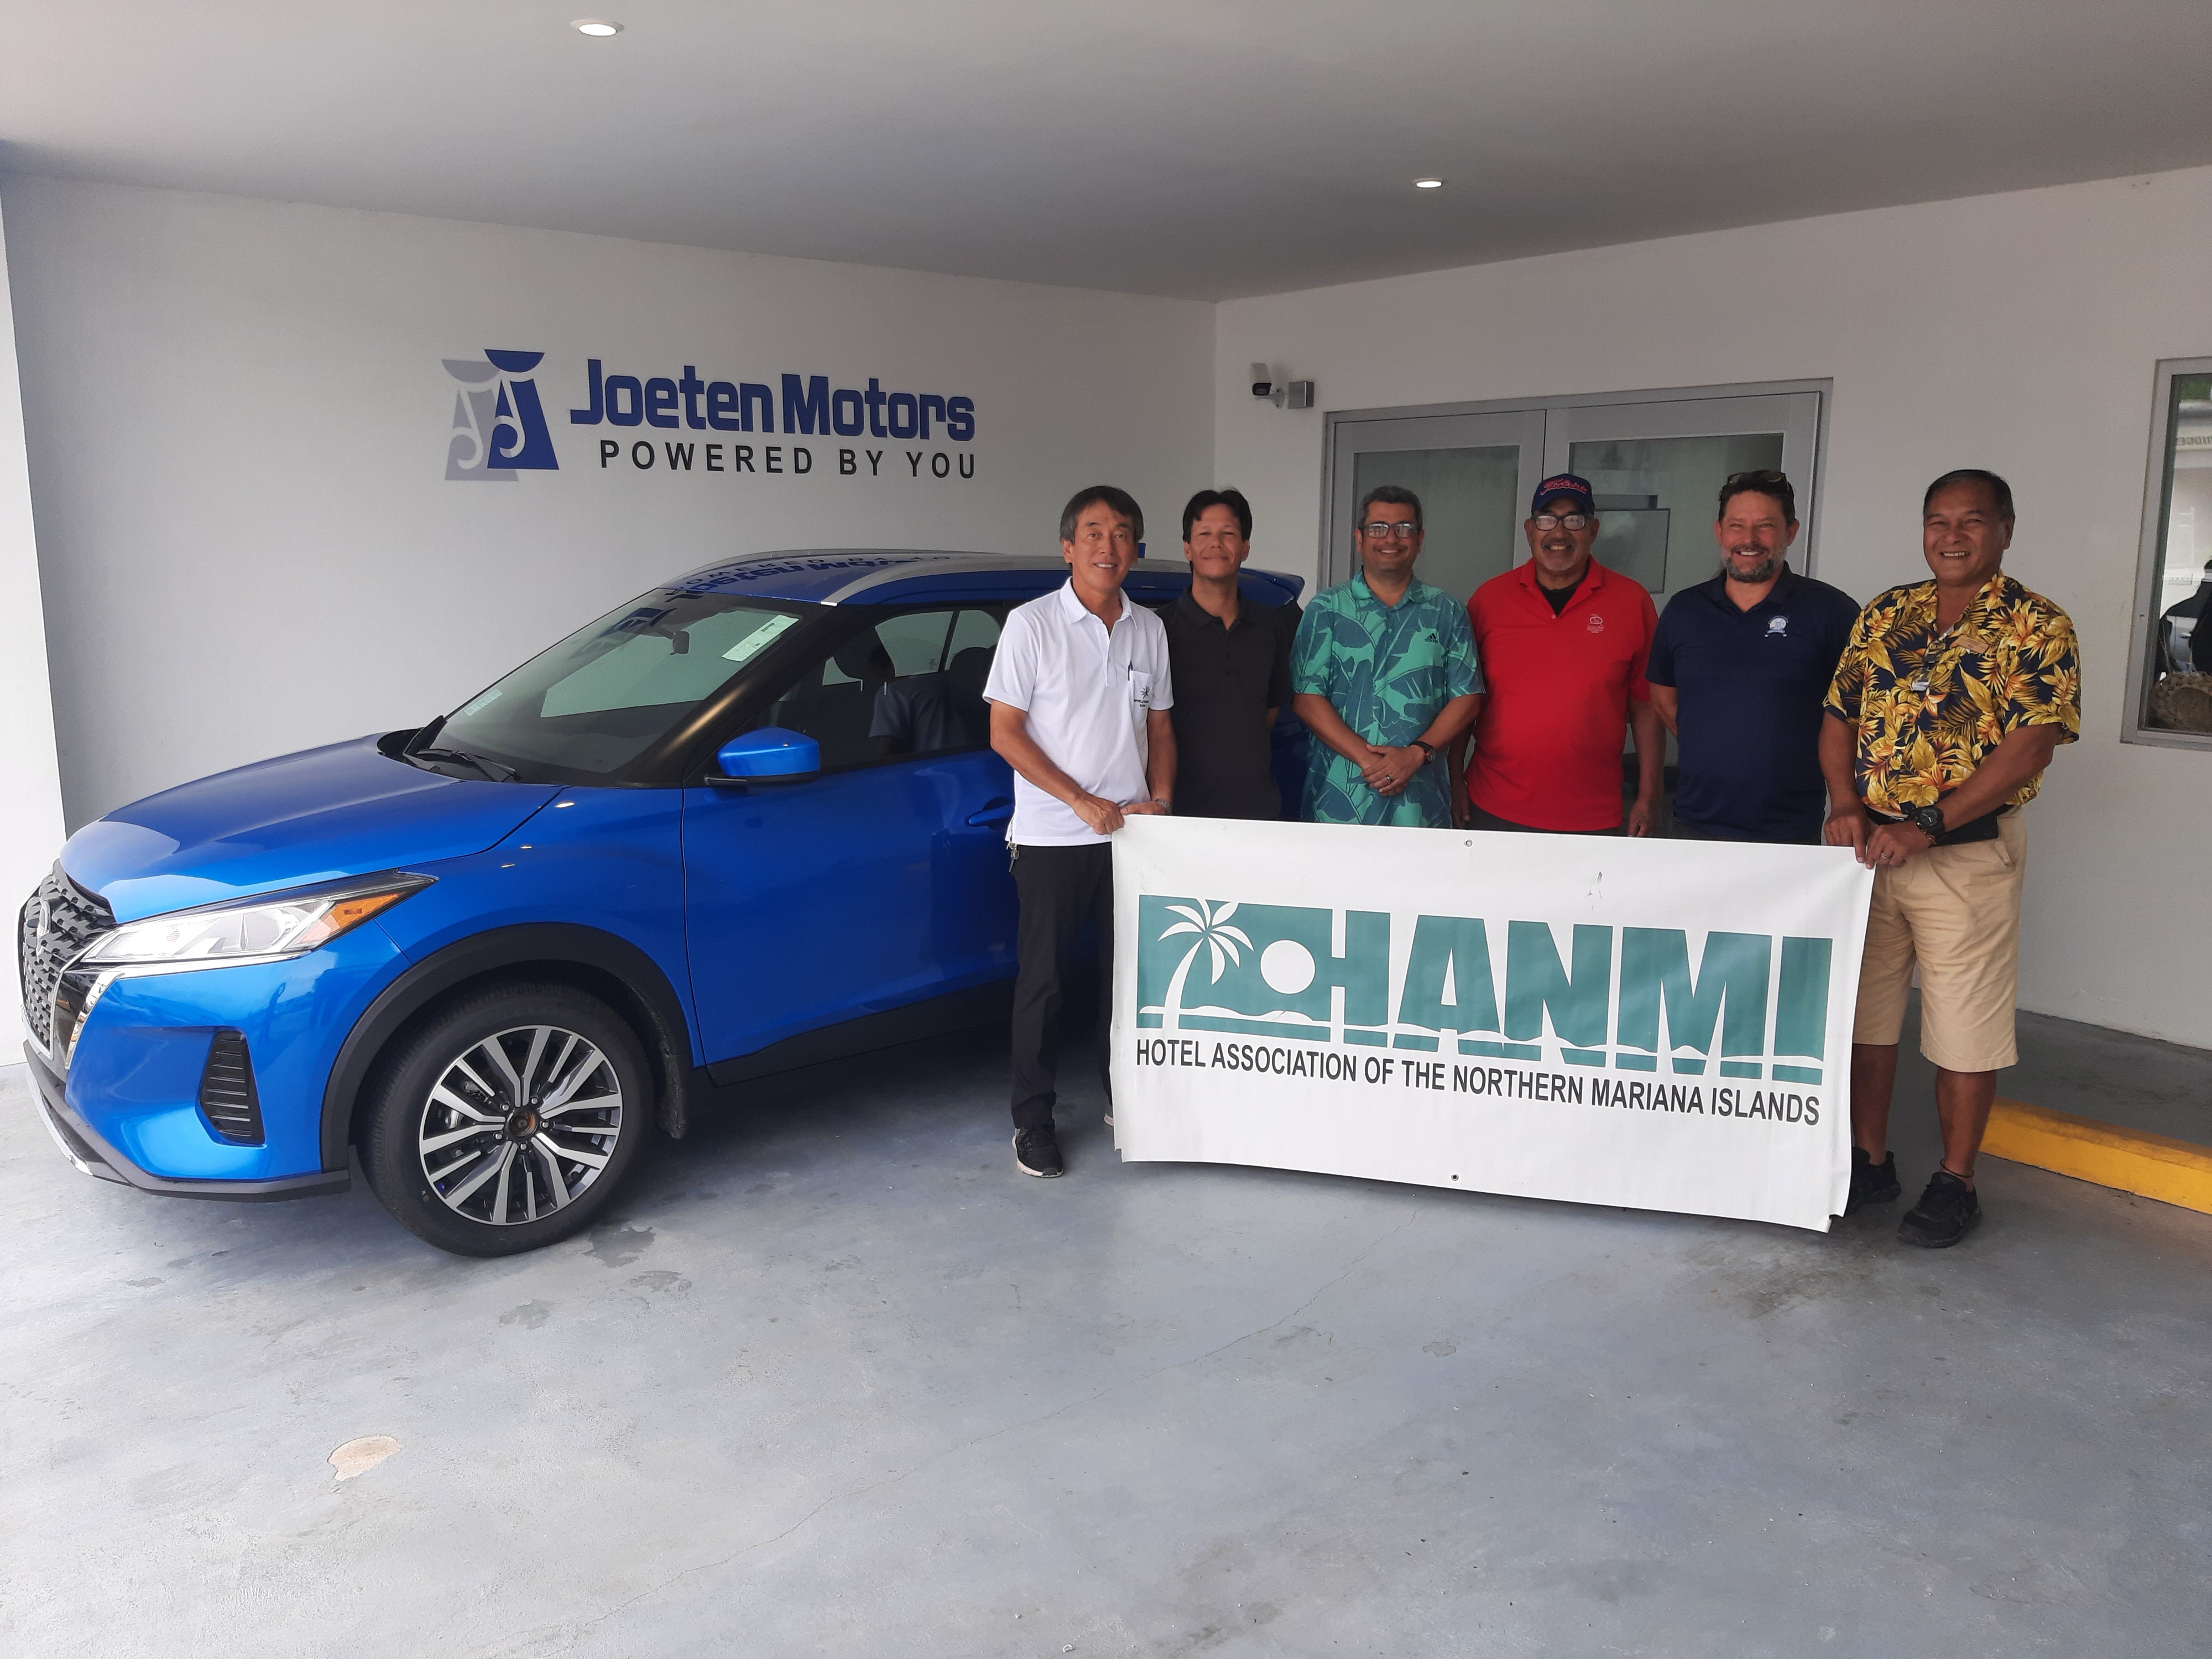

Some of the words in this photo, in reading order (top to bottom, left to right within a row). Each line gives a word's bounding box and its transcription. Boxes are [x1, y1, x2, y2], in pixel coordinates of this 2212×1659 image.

[570, 358, 775, 434] Joeten
[781, 373, 975, 442] Motors
[600, 440, 812, 474] POWERED
[839, 448, 884, 476] BY
[905, 451, 974, 479] YOU
[1136, 894, 1833, 1086] HANMI
[1137, 1039, 1206, 1067] HOTEL
[1211, 1042, 1357, 1082] ASSOCIATION
[1364, 1057, 1394, 1084] OF
[1401, 1060, 1446, 1091] THE
[1453, 1065, 1583, 1104] NORTHERN
[1592, 1078, 1704, 1114] MARIANA
[1711, 1087, 1819, 1126] ISLANDS
